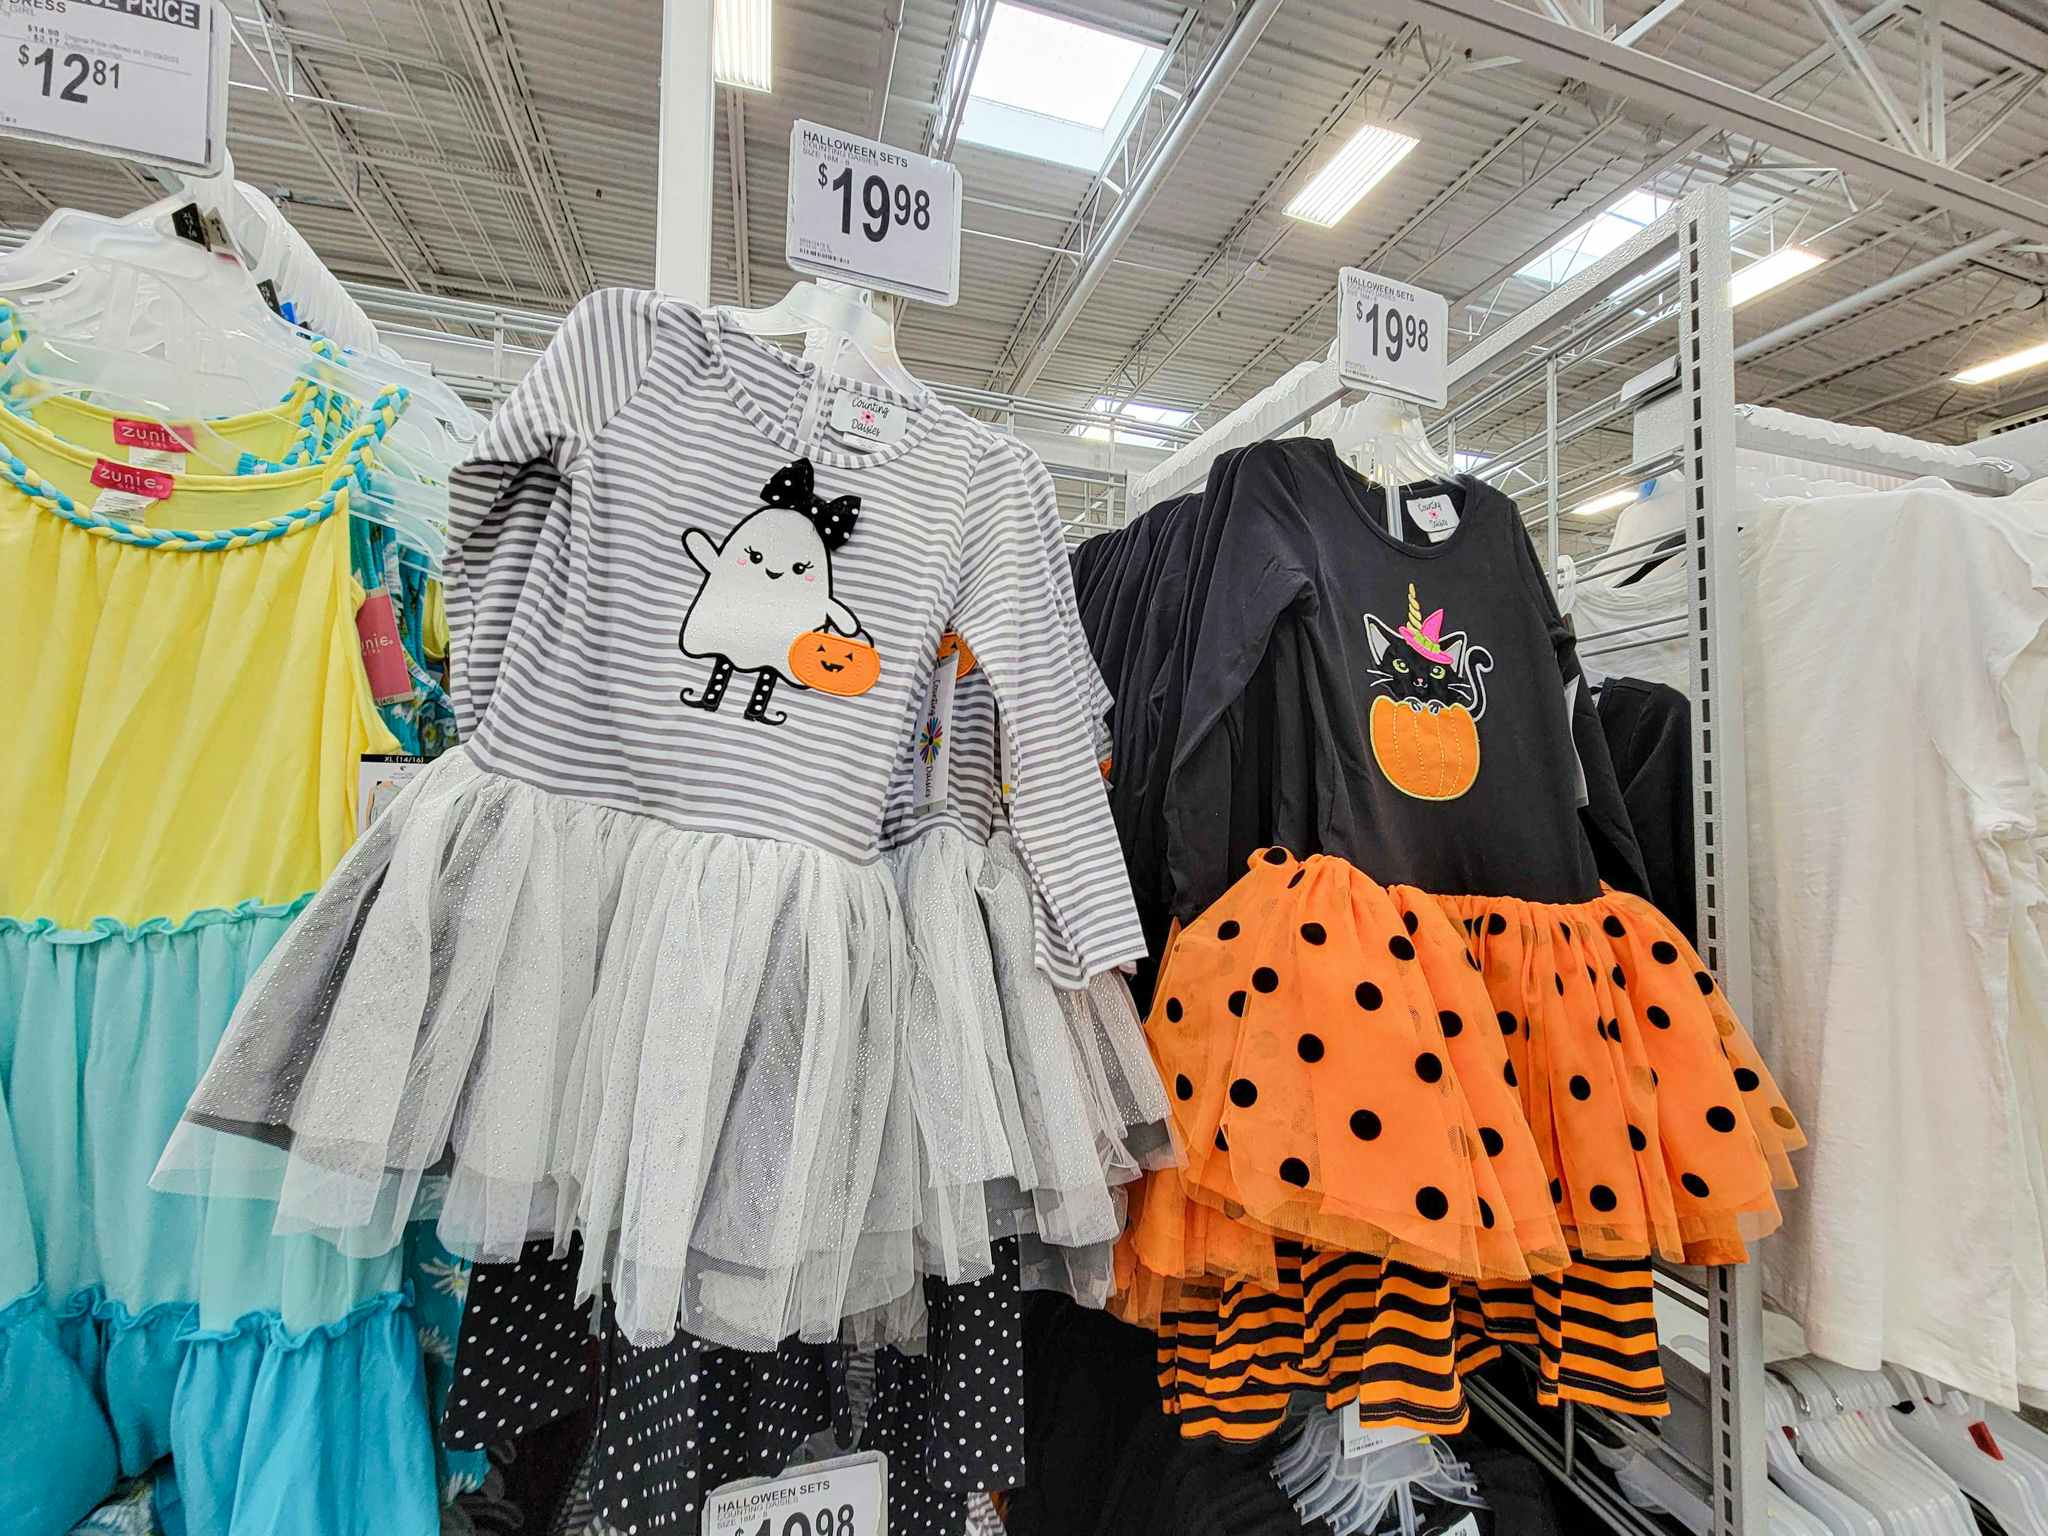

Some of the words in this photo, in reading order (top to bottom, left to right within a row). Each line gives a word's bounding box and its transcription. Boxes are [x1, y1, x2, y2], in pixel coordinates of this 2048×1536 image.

[125, 0, 196, 26] PRICE
[803, 130, 877, 159] HALLOWEEN
[879, 152, 908, 168] SETS
[717, 1487, 796, 1513] HALLOWEEN
[799, 1480, 830, 1495] SETS
